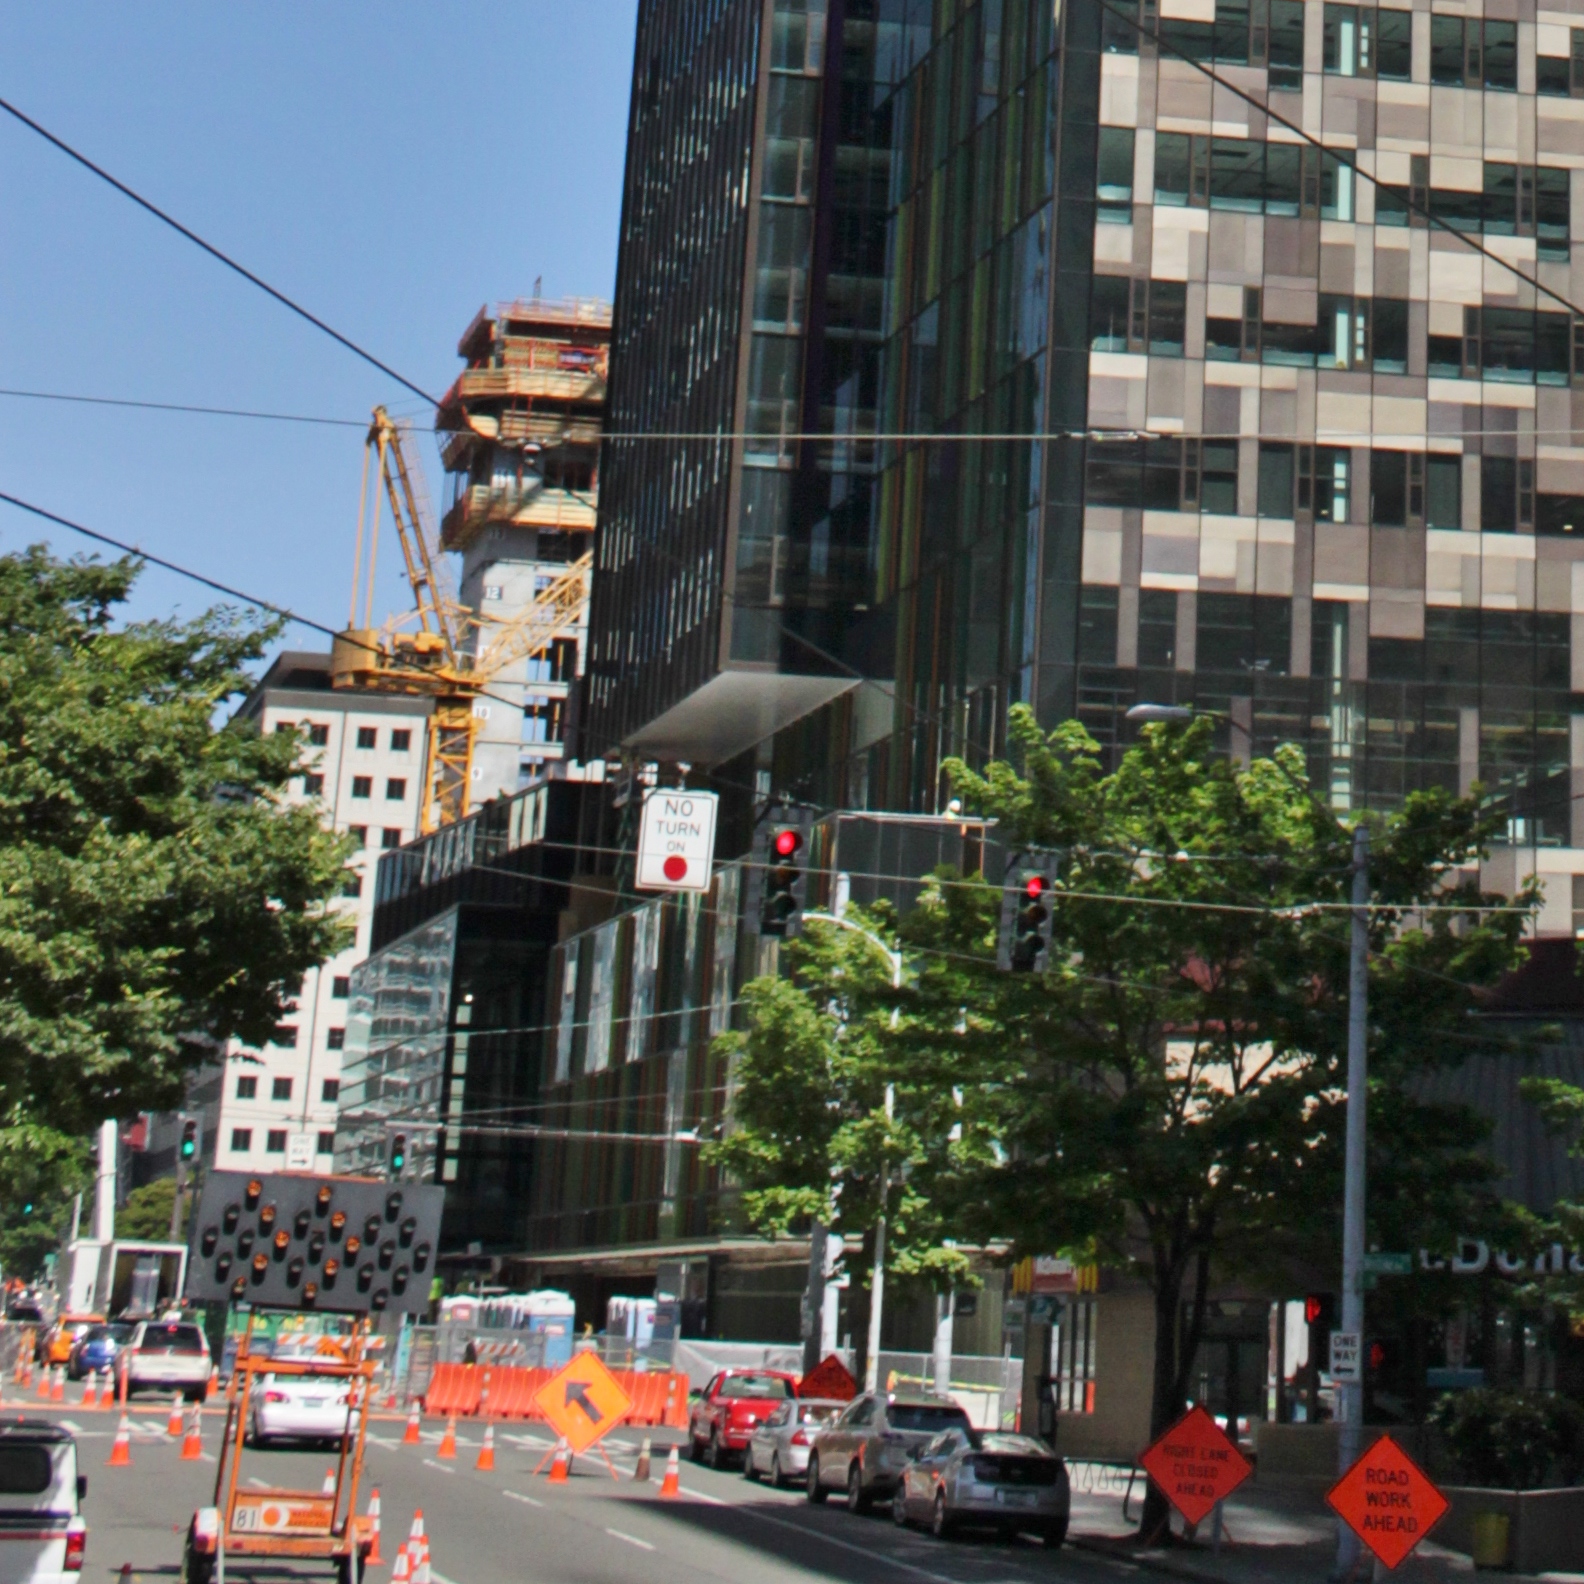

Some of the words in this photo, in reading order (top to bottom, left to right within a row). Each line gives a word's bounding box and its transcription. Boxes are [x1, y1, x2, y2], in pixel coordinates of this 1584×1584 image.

[475, 707, 488, 717] 10
[664, 798, 694, 816] NO
[656, 820, 701, 837] TURN
[666, 840, 685, 852] ON
[1333, 1335, 1357, 1348] ONE
[1333, 1349, 1357, 1361] WAY
[1163, 1444, 1195, 1459] RIGHT
[1201, 1447, 1230, 1462] LANE
[1173, 1463, 1219, 1479] CLOSED
[1365, 1468, 1410, 1486] ROAD
[1176, 1483, 1216, 1499] AHEAD
[1366, 1491, 1412, 1509] WORK
[236, 1509, 257, 1529] 81
[1362, 1515, 1418, 1533] AHEAD
